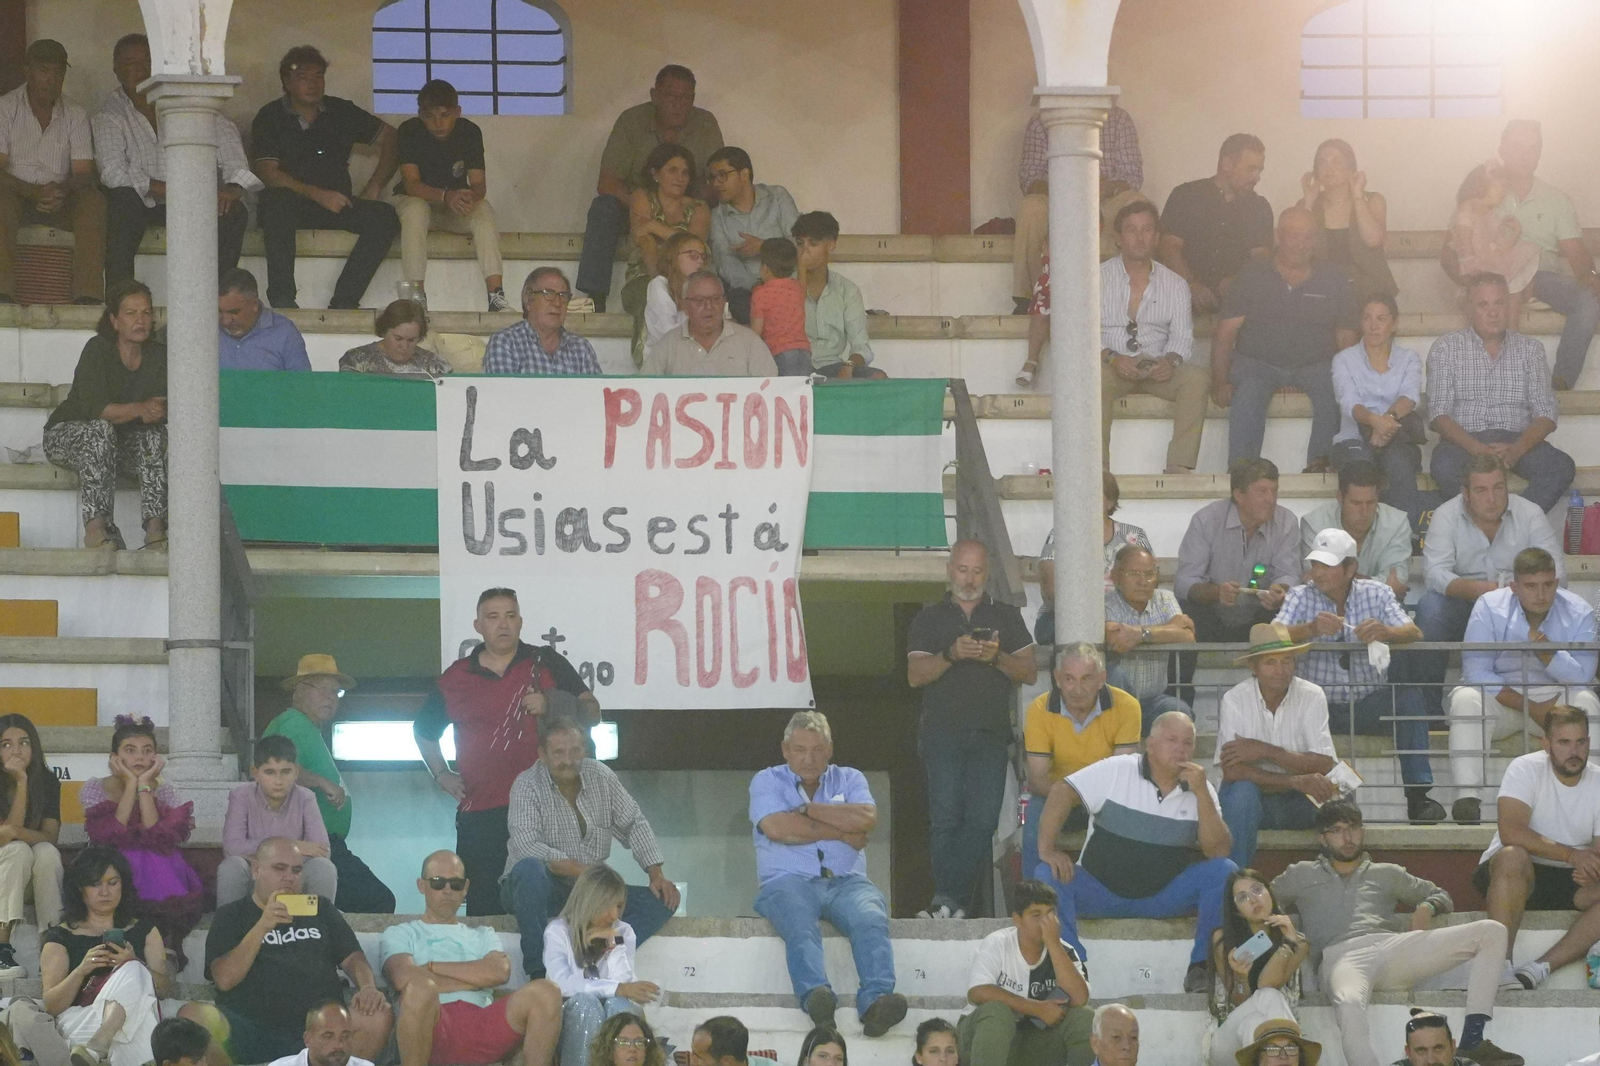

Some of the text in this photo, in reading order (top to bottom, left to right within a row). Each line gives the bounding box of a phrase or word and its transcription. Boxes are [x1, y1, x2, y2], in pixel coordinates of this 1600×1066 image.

[878, 240, 888, 249] 11
[982, 240, 994, 249] 12
[1014, 399, 1024, 408] 10
[459, 379, 808, 472] La PASIÓN
[1155, 480, 1164, 489] 11
[461, 481, 789, 556] Usias está
[633, 560, 808, 689] ROCÍO
[261, 926, 322, 946] didas
[684, 966, 696, 977] 72
[915, 969, 926, 979] 74
[1139, 968, 1151, 979] 76
